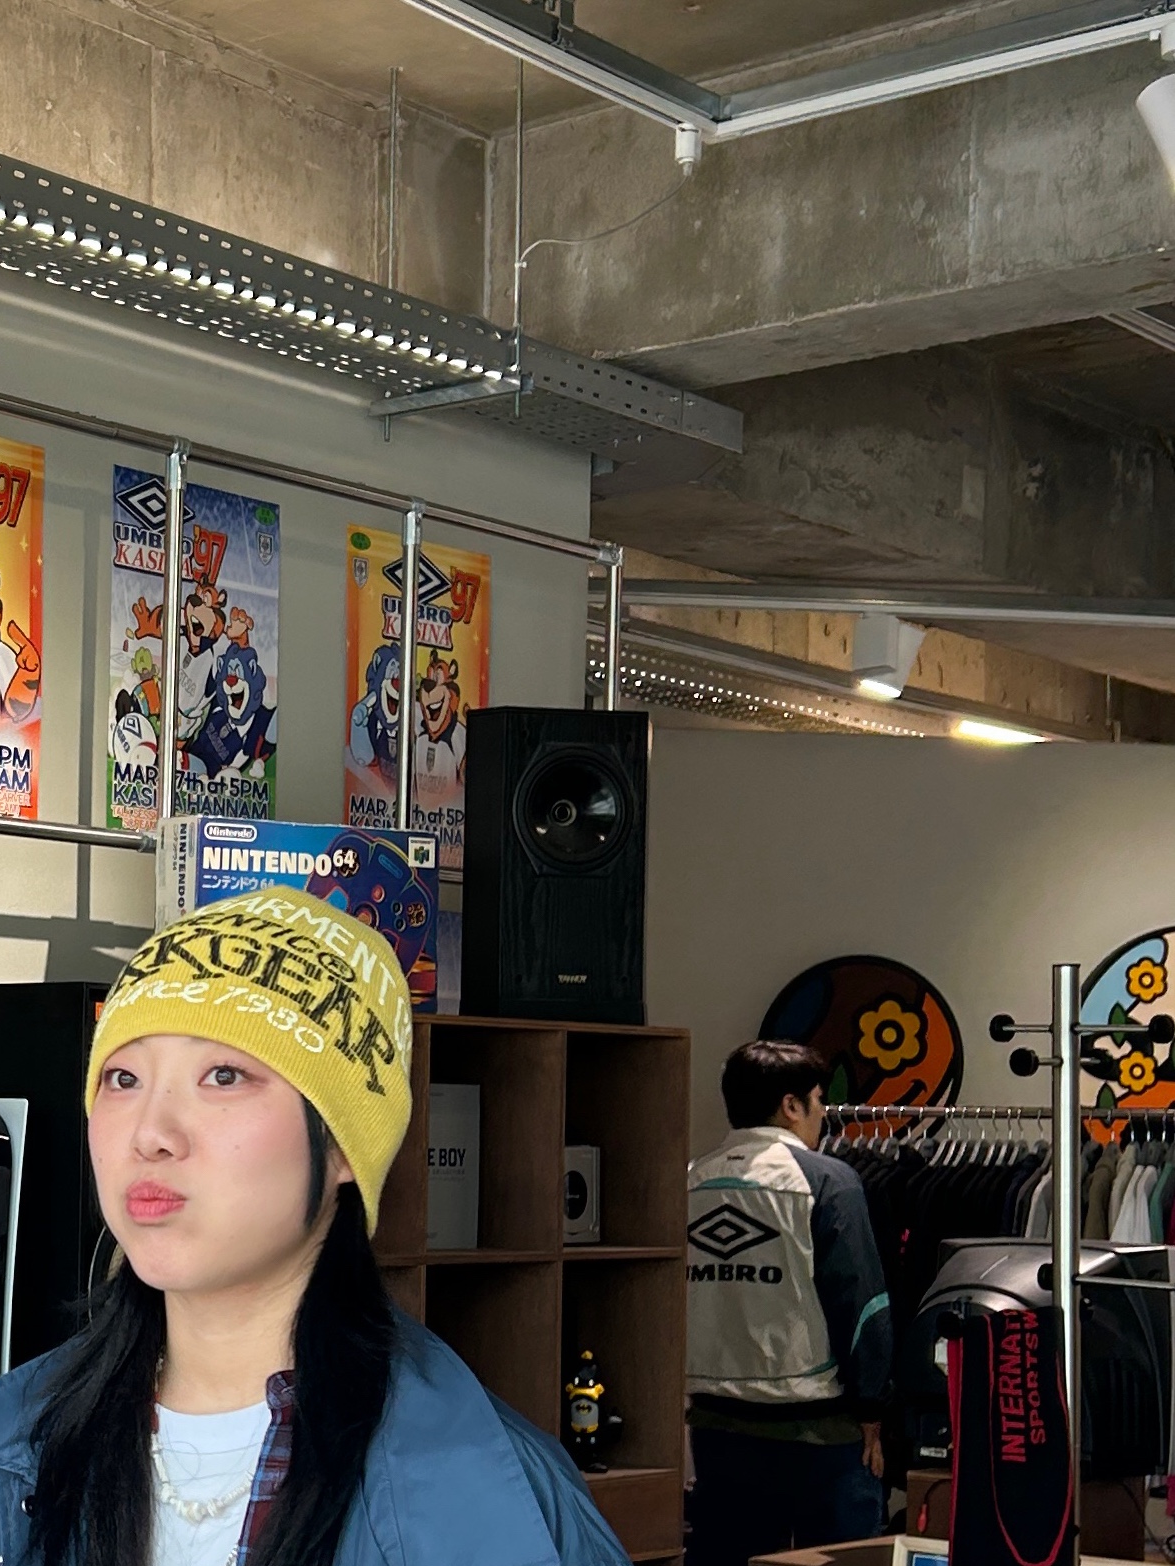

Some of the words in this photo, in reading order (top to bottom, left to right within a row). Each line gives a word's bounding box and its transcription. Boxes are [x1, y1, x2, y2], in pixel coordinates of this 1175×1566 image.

[115, 523, 191, 557] UMBO
[116, 543, 192, 577] KASIA
[383, 595, 451, 624] UBRO
[176, 769, 205, 794] 7th
[208, 776, 227, 797] at
[230, 776, 269, 801] 5PM
[207, 825, 255, 840] Nintendo
[446, 807, 465, 828] 5P
[178, 823, 187, 909] NINTENDO
[202, 846, 333, 878] NINTENDO
[202, 875, 259, 890] ニンテンドウ
[111, 927, 396, 1097] RKGEAR
[438, 1148, 467, 1167] BOY
